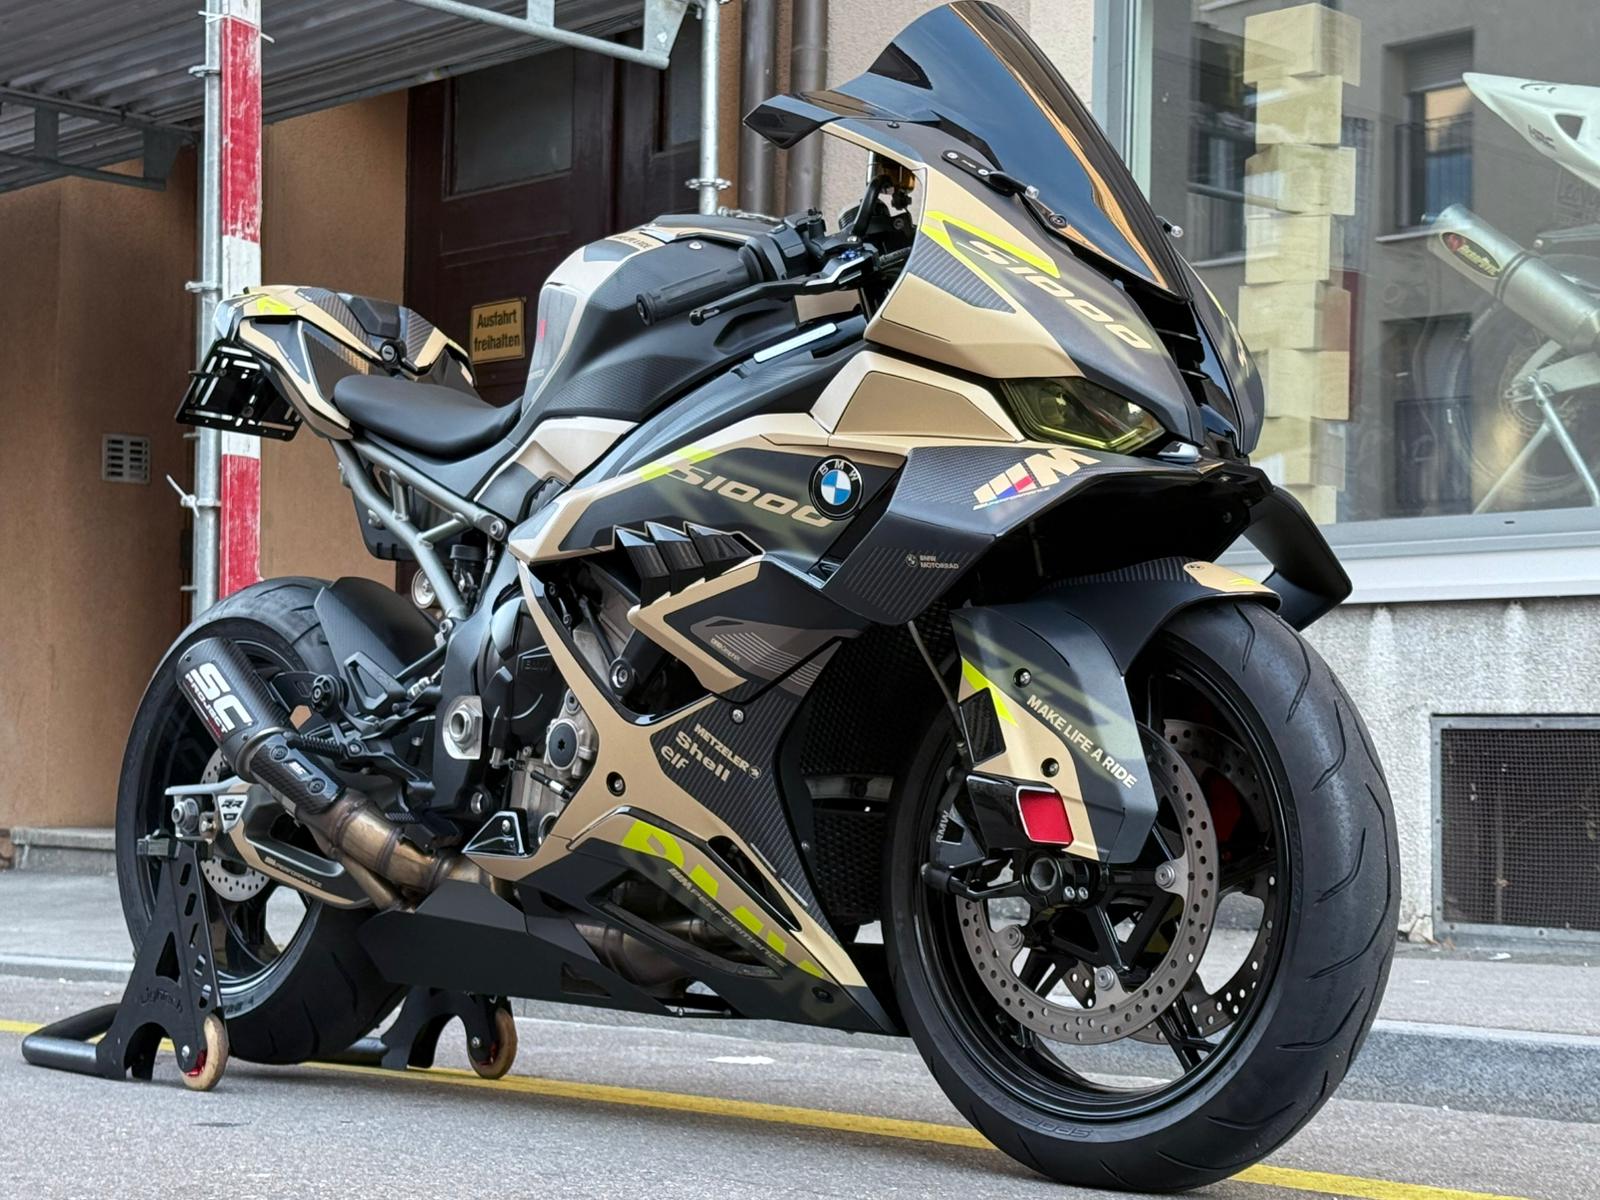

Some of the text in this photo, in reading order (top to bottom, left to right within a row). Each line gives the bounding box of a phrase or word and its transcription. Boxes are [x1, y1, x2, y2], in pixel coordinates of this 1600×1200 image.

[955, 240, 1153, 350] S1000
[477, 309, 517, 329] Ausfahrt
[474, 333, 521, 352] freihalten
[819, 459, 859, 482] BMW
[920, 561, 960, 569] MOTORRAD
[198, 662, 254, 732] SC
[660, 744, 690, 770] elf
[675, 730, 731, 782] Shell
[693, 722, 751, 773] METZELER
[1026, 694, 1138, 789] MAKE LIFE A RIDE
